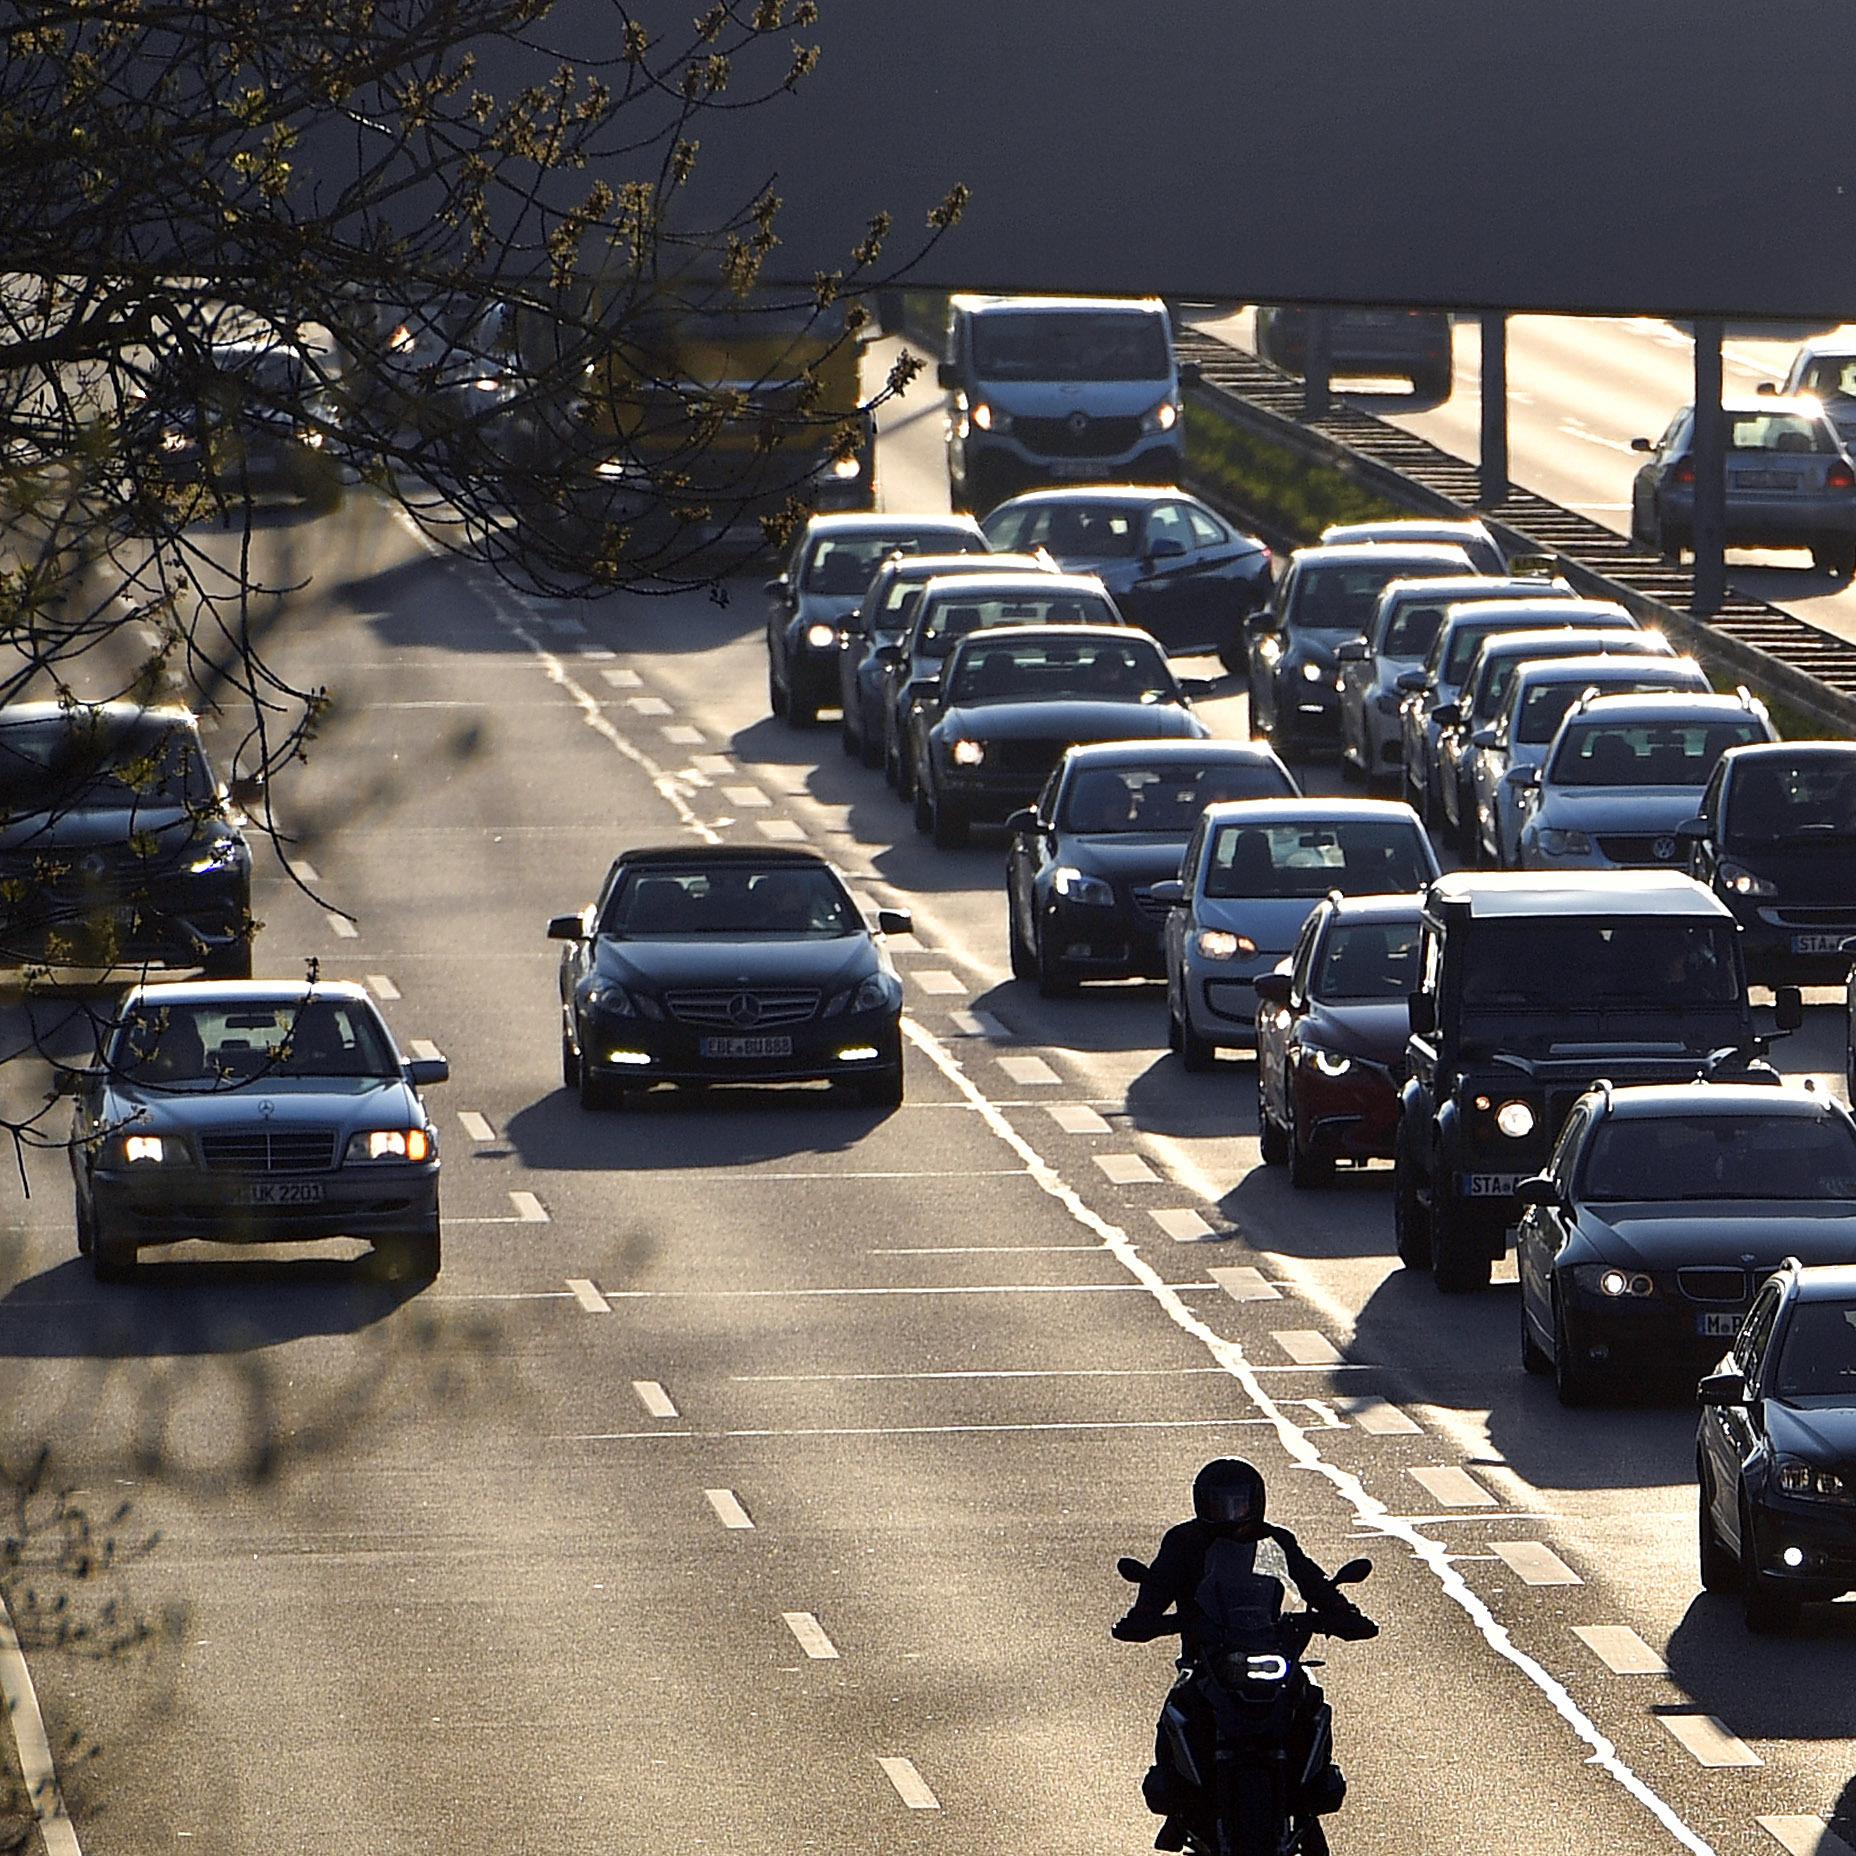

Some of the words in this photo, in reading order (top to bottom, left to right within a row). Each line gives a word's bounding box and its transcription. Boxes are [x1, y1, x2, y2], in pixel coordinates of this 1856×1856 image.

[1800, 937, 1827, 951] STA
[1472, 1177, 1501, 1193] STA
[1707, 1316, 1719, 1334] M
